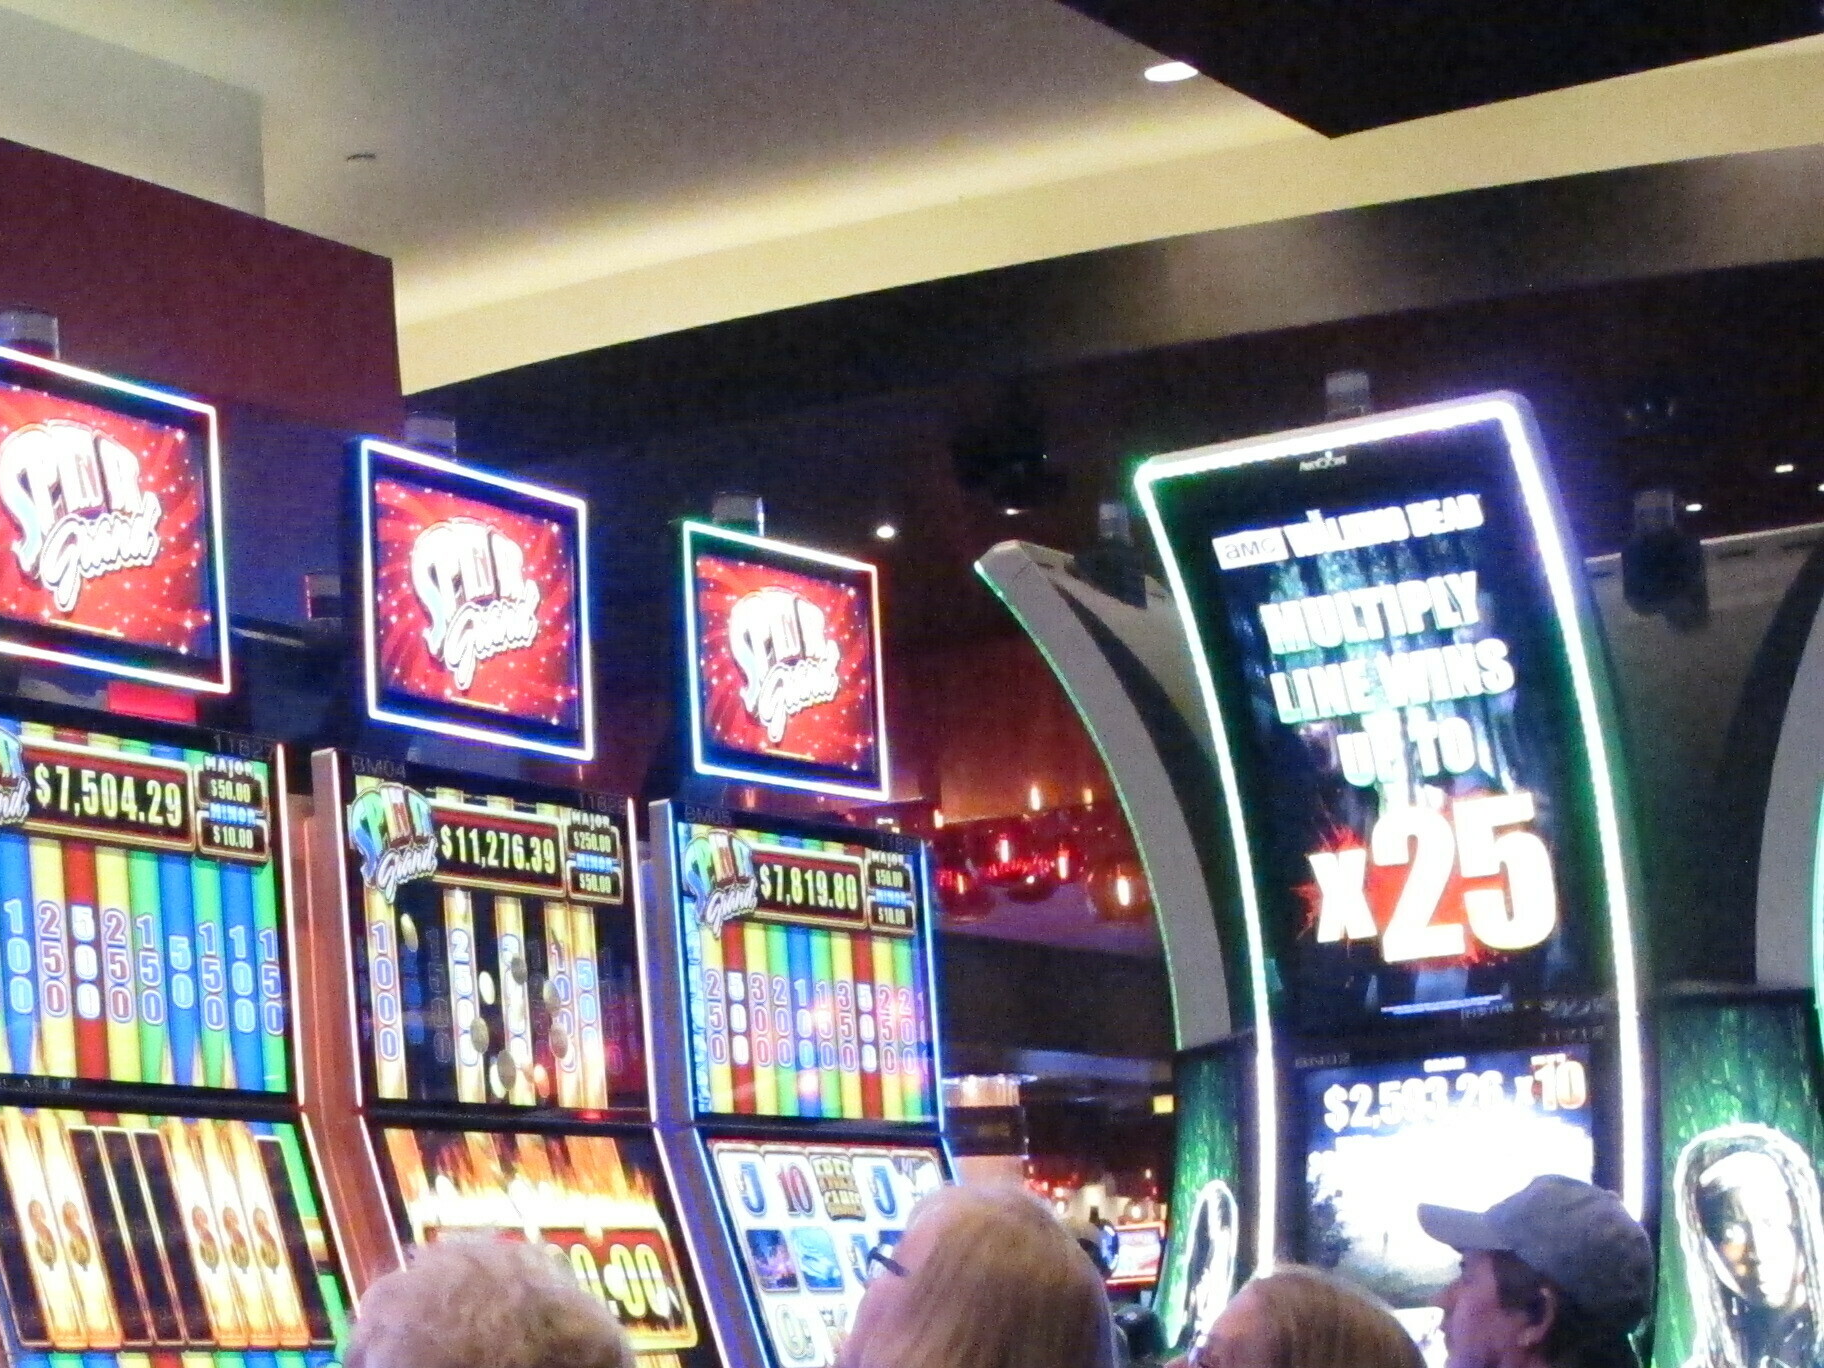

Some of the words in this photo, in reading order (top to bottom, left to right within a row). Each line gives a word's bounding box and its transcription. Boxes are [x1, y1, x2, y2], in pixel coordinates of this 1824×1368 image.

[1259, 570, 1482, 654] MULTIPLY
[1377, 637, 1516, 709] WINS
[34, 762, 183, 827] $7,504.29
[204, 755, 254, 778] MAJOR
[210, 778, 251, 803] $50.00
[209, 802, 256, 826] MINOR
[213, 825, 254, 849] $10.00
[441, 824, 556, 874] $11,276.39
[571, 810, 610, 831] MAJOR
[760, 863, 858, 910] $7,819.80
[4, 899, 34, 1014] 100
[37, 901, 67, 1017] 250
[104, 908, 133, 1023] 250
[136, 912, 166, 1026] 150
[169, 935, 195, 1010] 50
[198, 921, 227, 1031] 150
[229, 924, 256, 1034] 100
[258, 928, 285, 1035] 150
[372, 921, 401, 1061] 1000
[778, 1163, 815, 1216] 10
